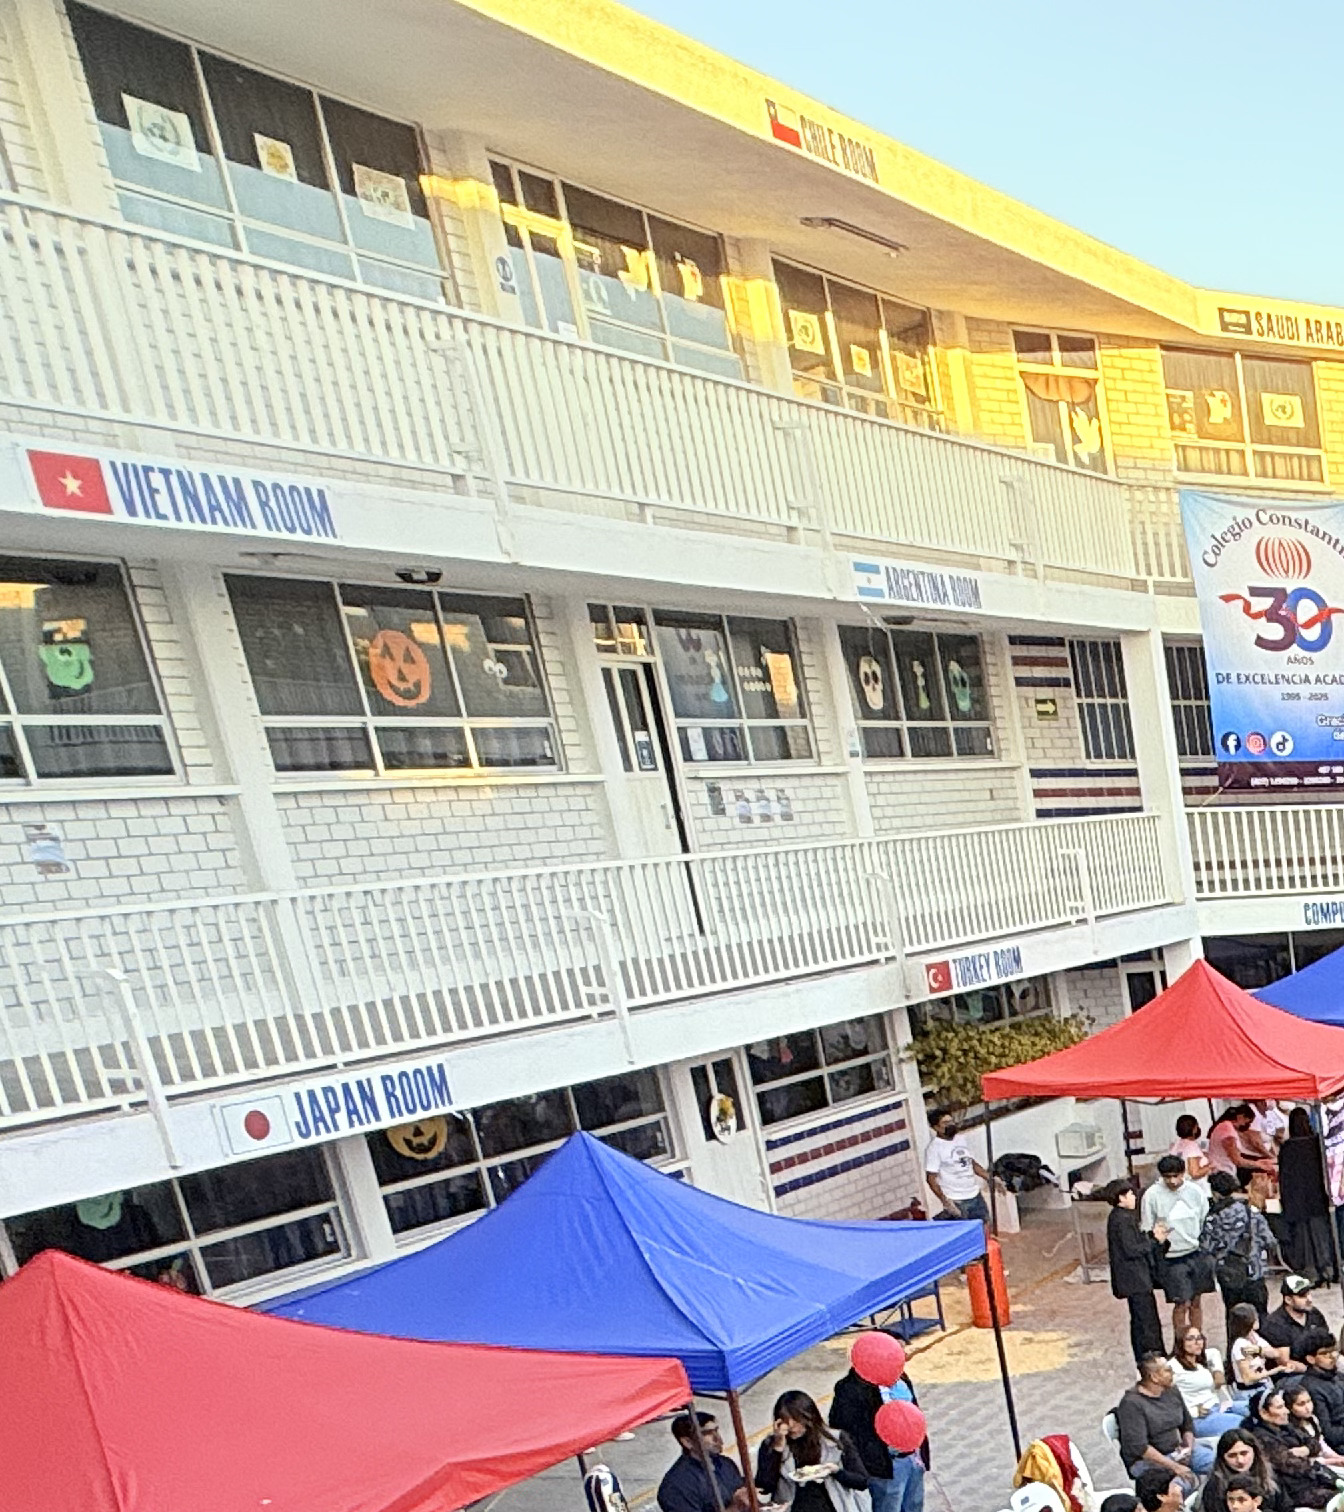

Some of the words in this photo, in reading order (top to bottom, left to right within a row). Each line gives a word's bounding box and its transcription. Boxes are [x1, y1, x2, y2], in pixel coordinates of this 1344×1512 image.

[799, 114, 840, 167] CHILE
[837, 132, 879, 184] ROOM
[1254, 311, 1300, 341] SAUDI
[109, 460, 257, 530] VIETNAM
[251, 479, 338, 539] ROOM
[1201, 515, 1253, 568] Colegio
[885, 566, 951, 605] ARGENTINA
[948, 574, 982, 609] ROOM
[1246, 585, 1333, 653] 30
[1215, 672, 1232, 685] DE
[1236, 672, 1312, 685] EXCELENCIA
[1286, 654, 1315, 665] AÑOS
[952, 952, 992, 988] TURKEY
[993, 945, 1023, 979] ROOM
[293, 1077, 382, 1140] JAPAN
[380, 1062, 453, 1119] ROOM
